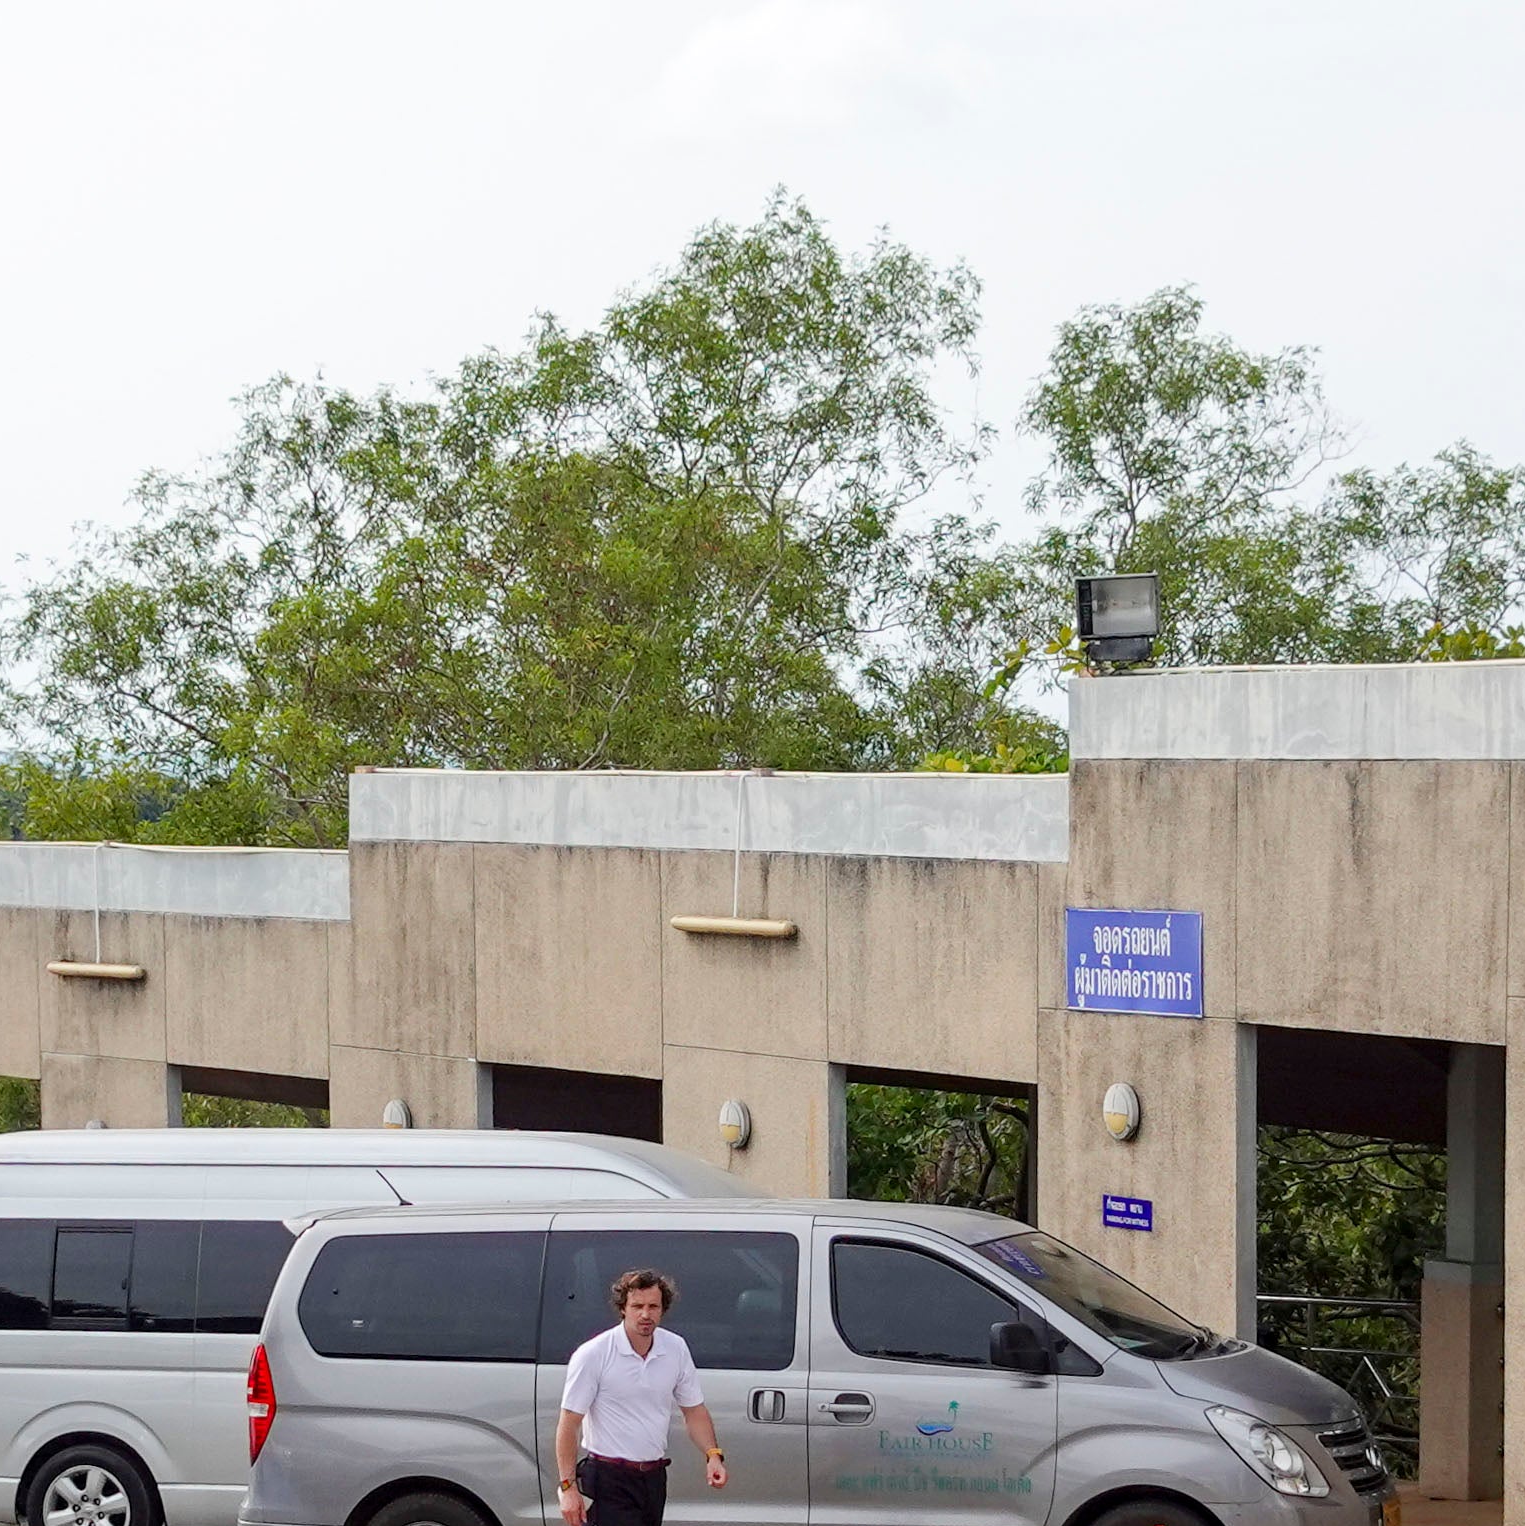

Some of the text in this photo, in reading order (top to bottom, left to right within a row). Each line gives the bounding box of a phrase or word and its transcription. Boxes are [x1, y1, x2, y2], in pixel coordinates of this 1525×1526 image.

[1092, 914, 1172, 958] จอดรถยนต์
[1074, 953, 1193, 1008] ผู้มาติดต่อราชการ
[878, 1430, 995, 1451] FAIR HOUSE
